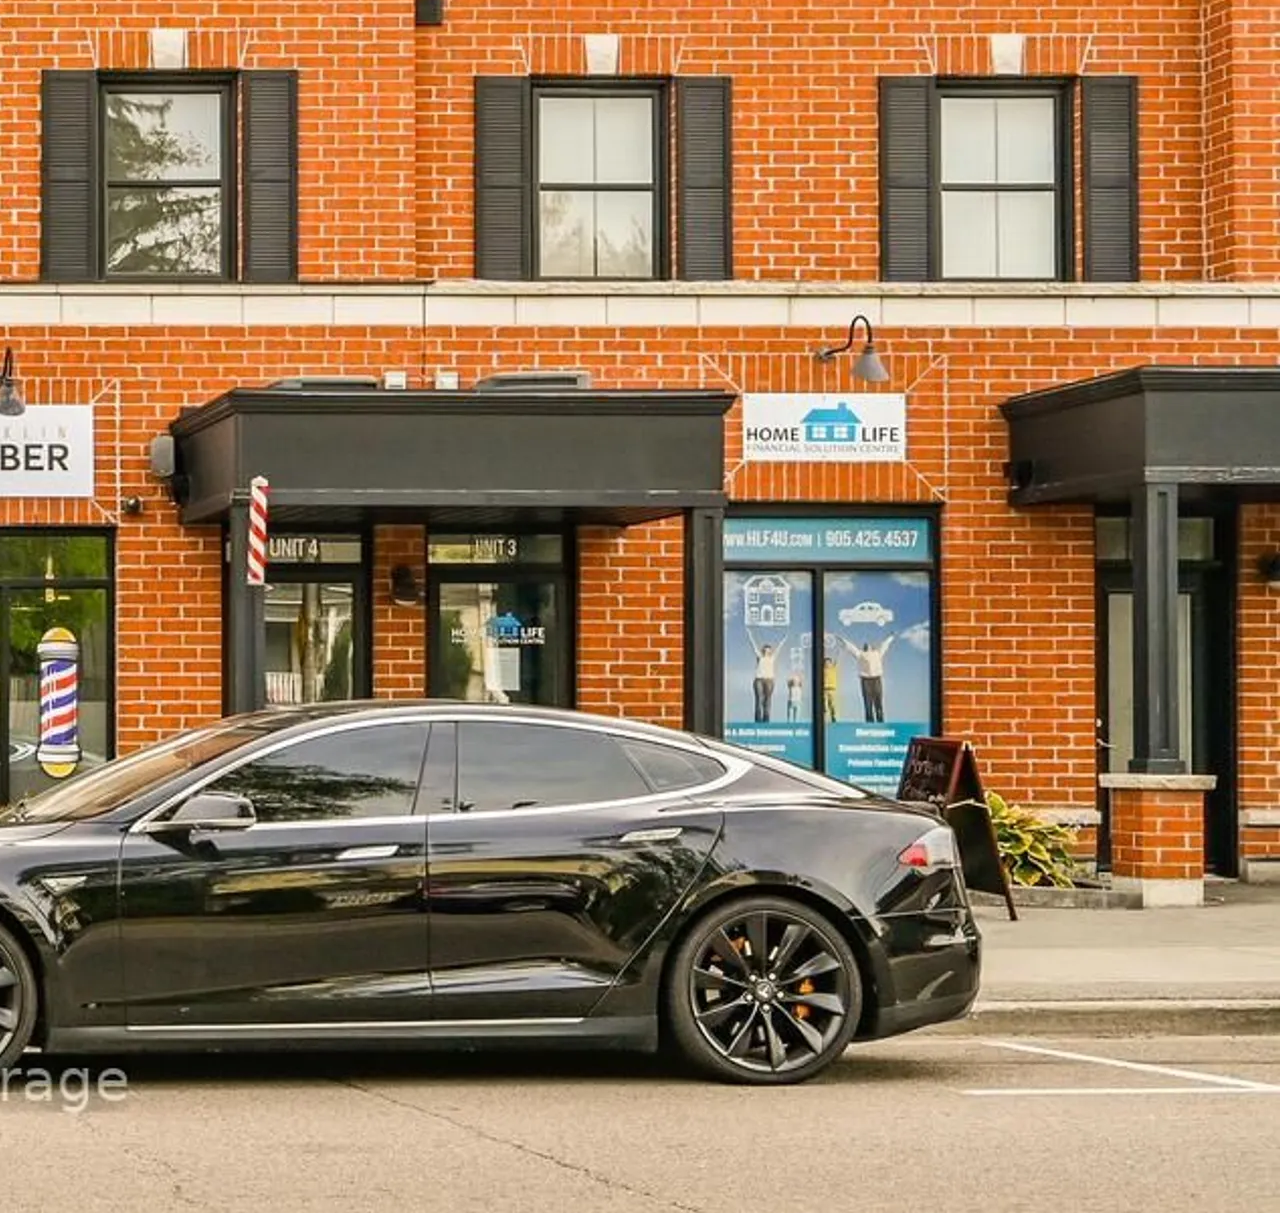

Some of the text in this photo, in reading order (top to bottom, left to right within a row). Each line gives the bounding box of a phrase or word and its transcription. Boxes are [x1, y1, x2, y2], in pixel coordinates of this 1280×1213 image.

[746, 427, 900, 442] HOME LIFE
[746, 444, 802, 454] FINANCIAL
[826, 529, 919, 548] 905.425.4537
[269, 538, 319, 558] UNIT 4
[507, 538, 517, 556] 3
[521, 627, 545, 637] LIFE
